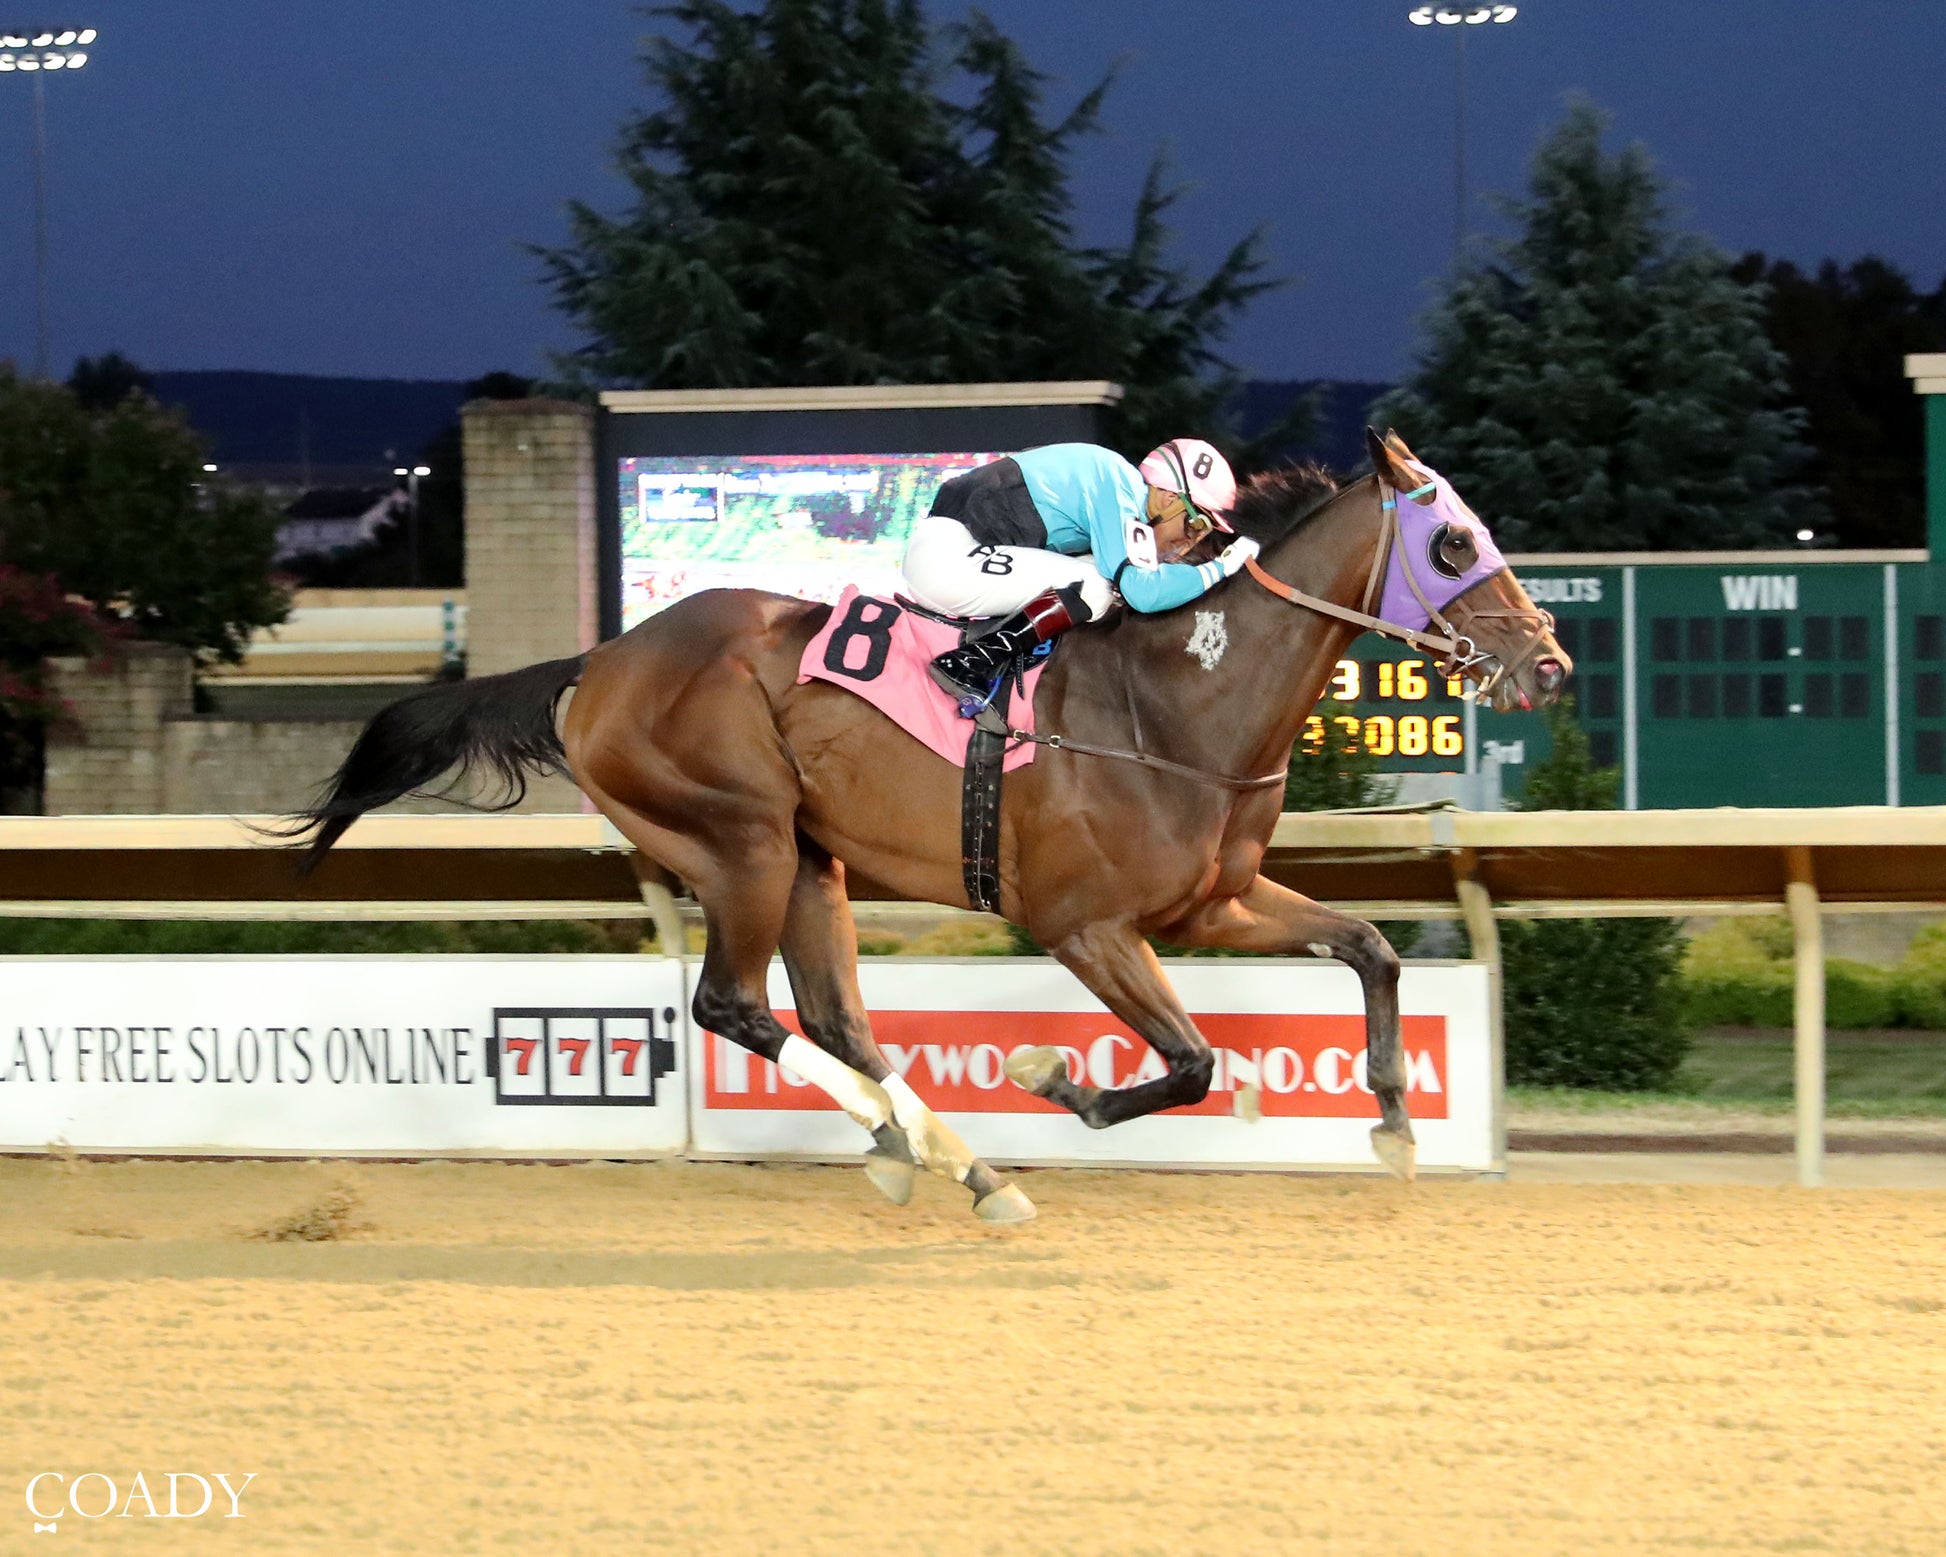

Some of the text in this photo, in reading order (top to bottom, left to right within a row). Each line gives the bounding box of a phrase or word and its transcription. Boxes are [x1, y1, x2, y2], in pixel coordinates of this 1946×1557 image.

[1193, 452, 1213, 480] 8
[1721, 575, 1797, 611] WIN
[822, 594, 903, 683] 8
[74, 1027, 175, 1082] FREE
[187, 1027, 312, 1084] SLOTS
[325, 1027, 473, 1084] ONLINE
[502, 1037, 647, 1076] 7 7 7
